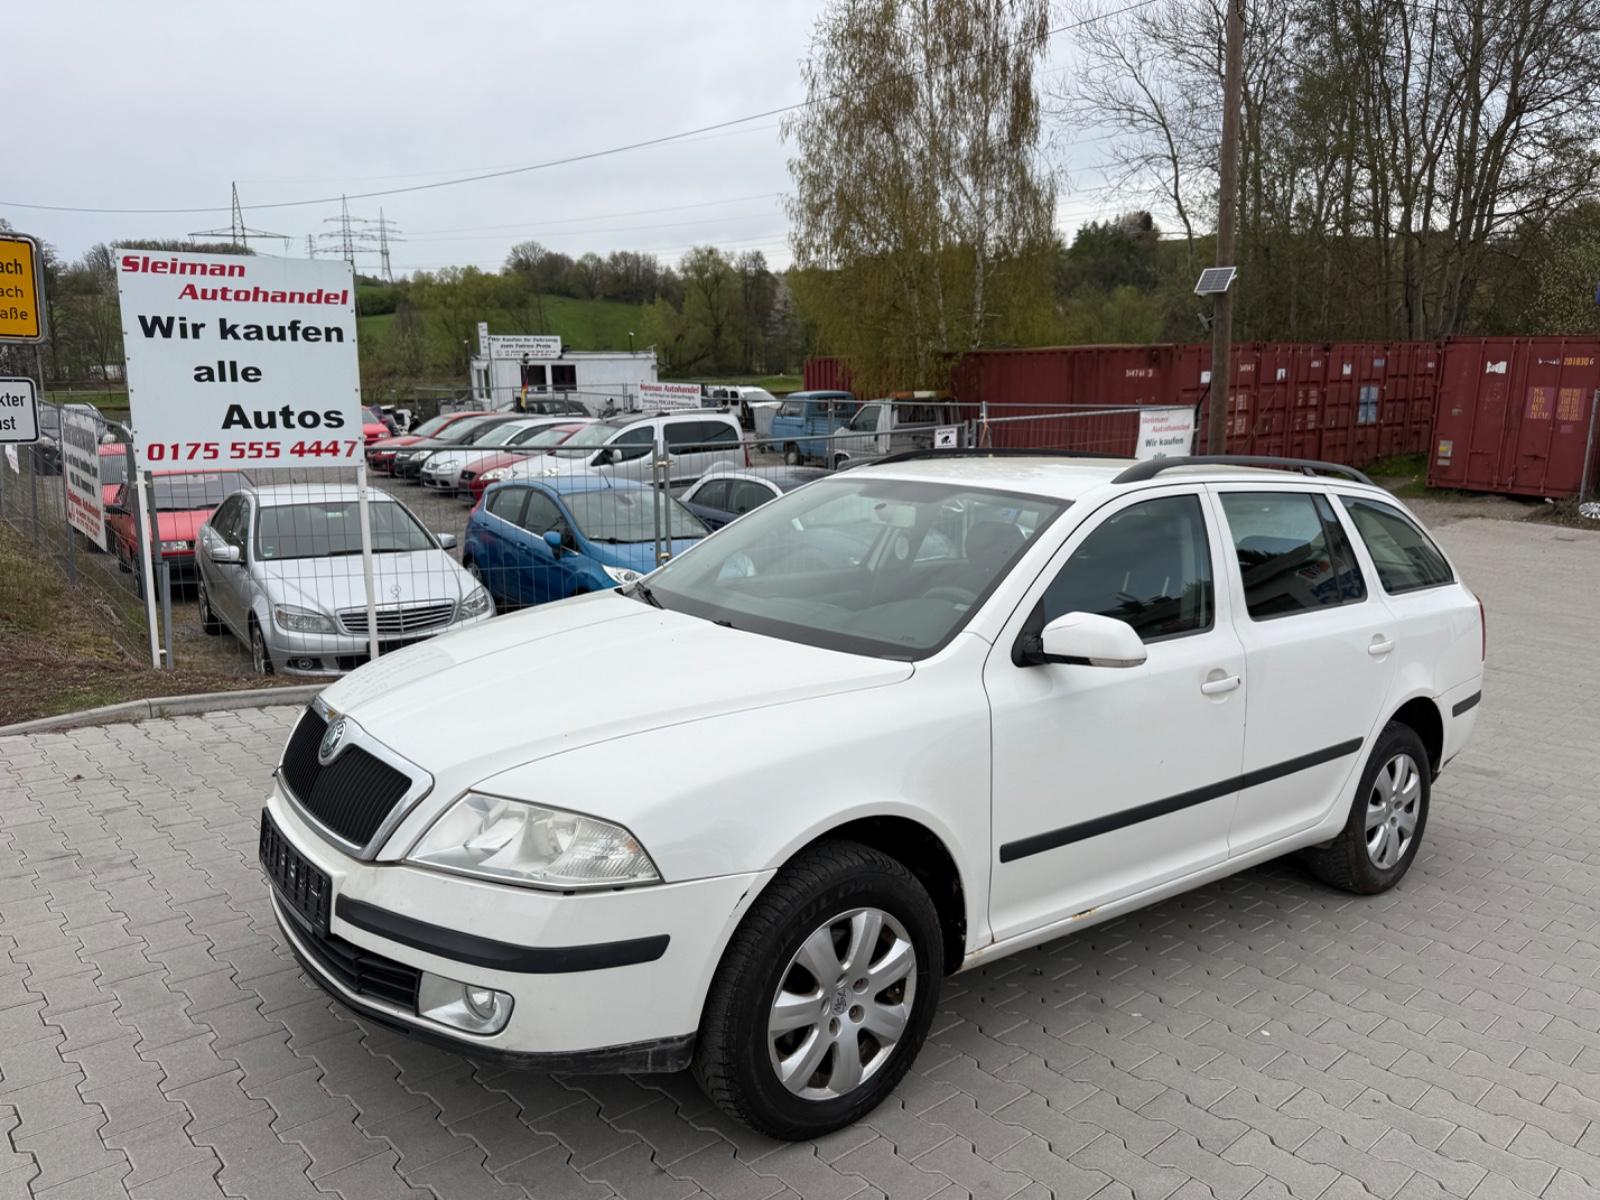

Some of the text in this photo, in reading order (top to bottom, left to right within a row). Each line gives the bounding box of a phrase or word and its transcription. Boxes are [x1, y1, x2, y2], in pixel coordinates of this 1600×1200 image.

[121, 255, 246, 277] Sleiman
[178, 283, 348, 305] Autohandel
[138, 315, 344, 343] Wir kaufen
[193, 360, 263, 383] alle
[221, 404, 345, 429] Autos
[147, 440, 358, 461] 0175 555 4447
[1145, 436, 1184, 448] Wir kaufen
